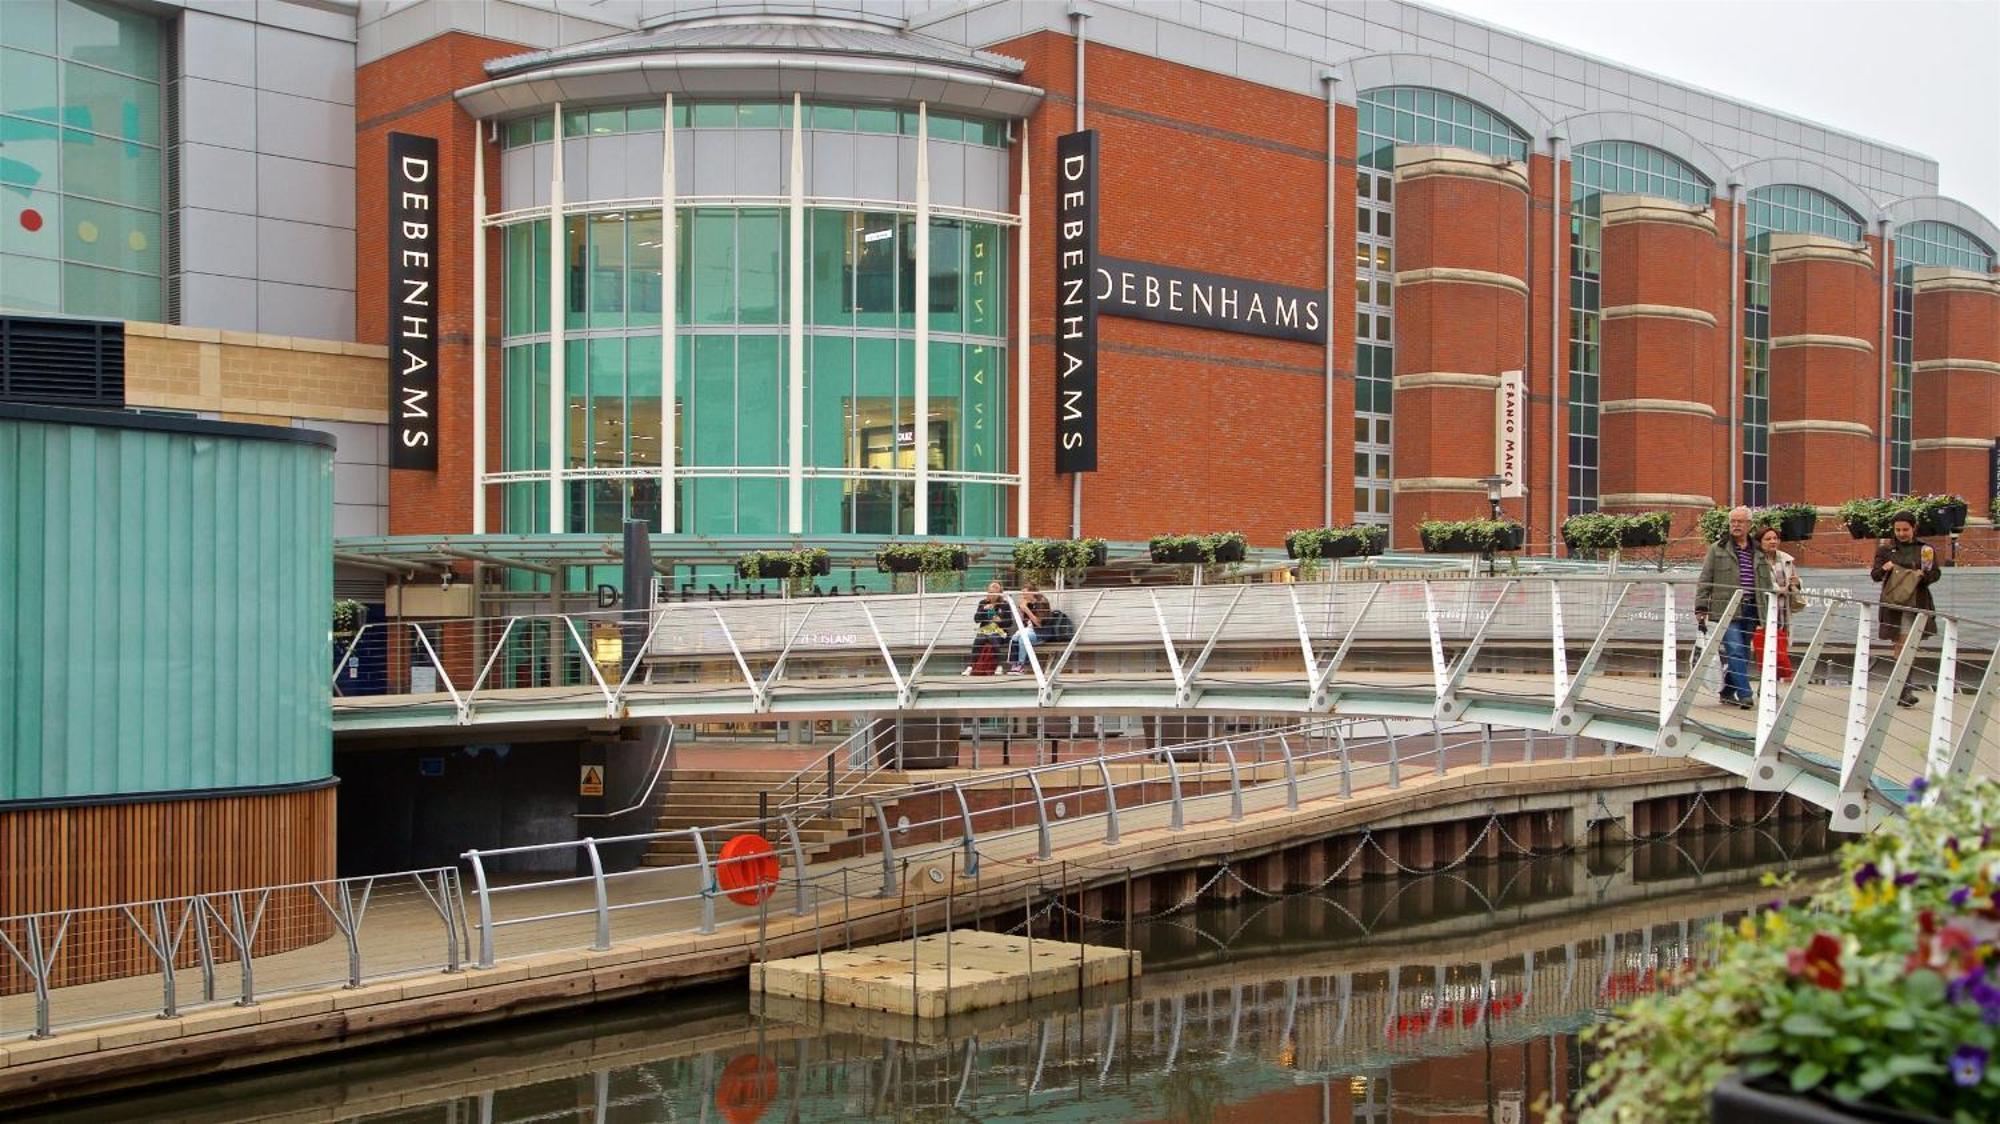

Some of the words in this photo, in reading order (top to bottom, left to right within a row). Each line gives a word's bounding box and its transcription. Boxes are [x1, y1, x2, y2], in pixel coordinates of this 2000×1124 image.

[402, 156, 429, 448] DEBENHAMS
[1063, 155, 1085, 450] DEBENHAMS
[1097, 267, 1319, 331] DEBENHAMS
[1506, 382, 1515, 433] FRANCO
[1504, 439, 1515, 487] MANCA
